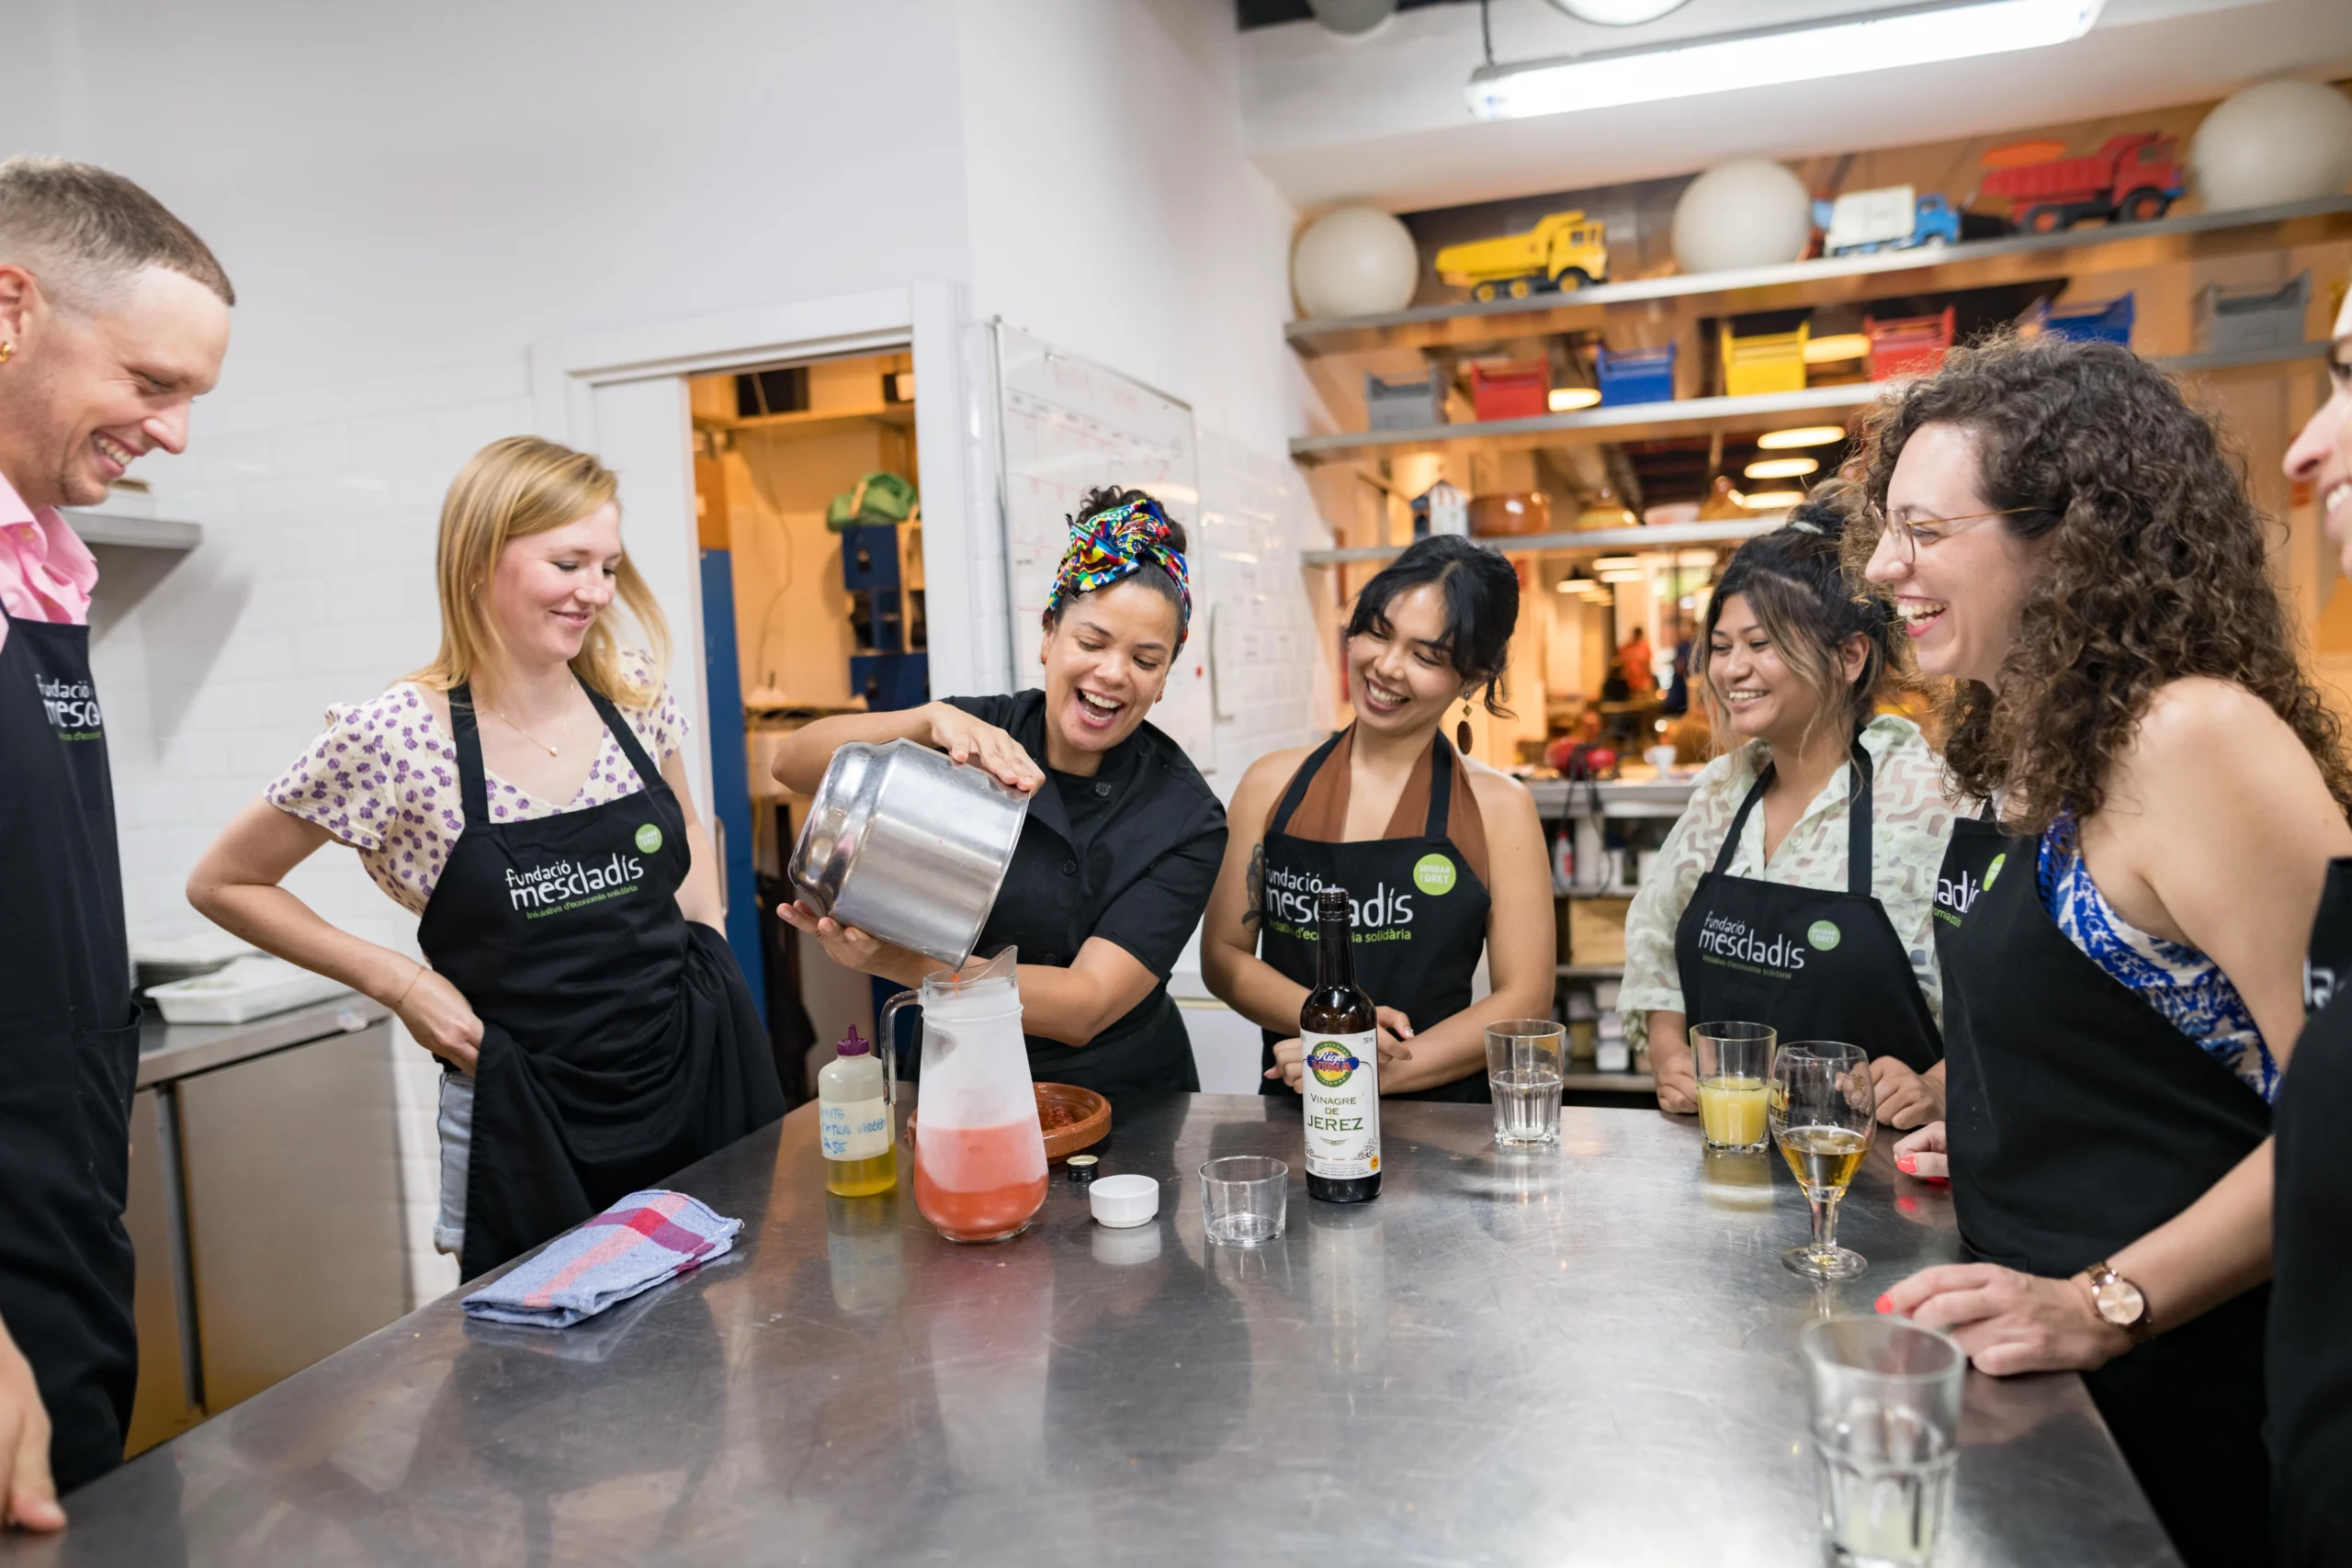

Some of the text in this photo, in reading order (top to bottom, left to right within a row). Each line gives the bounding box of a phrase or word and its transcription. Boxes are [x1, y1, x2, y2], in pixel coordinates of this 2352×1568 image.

[505, 859, 571, 887] fundació
[509, 852, 644, 910] mescladís
[1266, 882, 1414, 928] mesadís
[1365, 928, 1412, 943] solidària
[1704, 910, 1746, 936] fundació
[1698, 929, 1805, 970] mescladís
[1310, 1092, 1357, 1106] VINAGRE
[1324, 1107, 1340, 1116] DE
[1306, 1114, 1364, 1133] JEREZ
